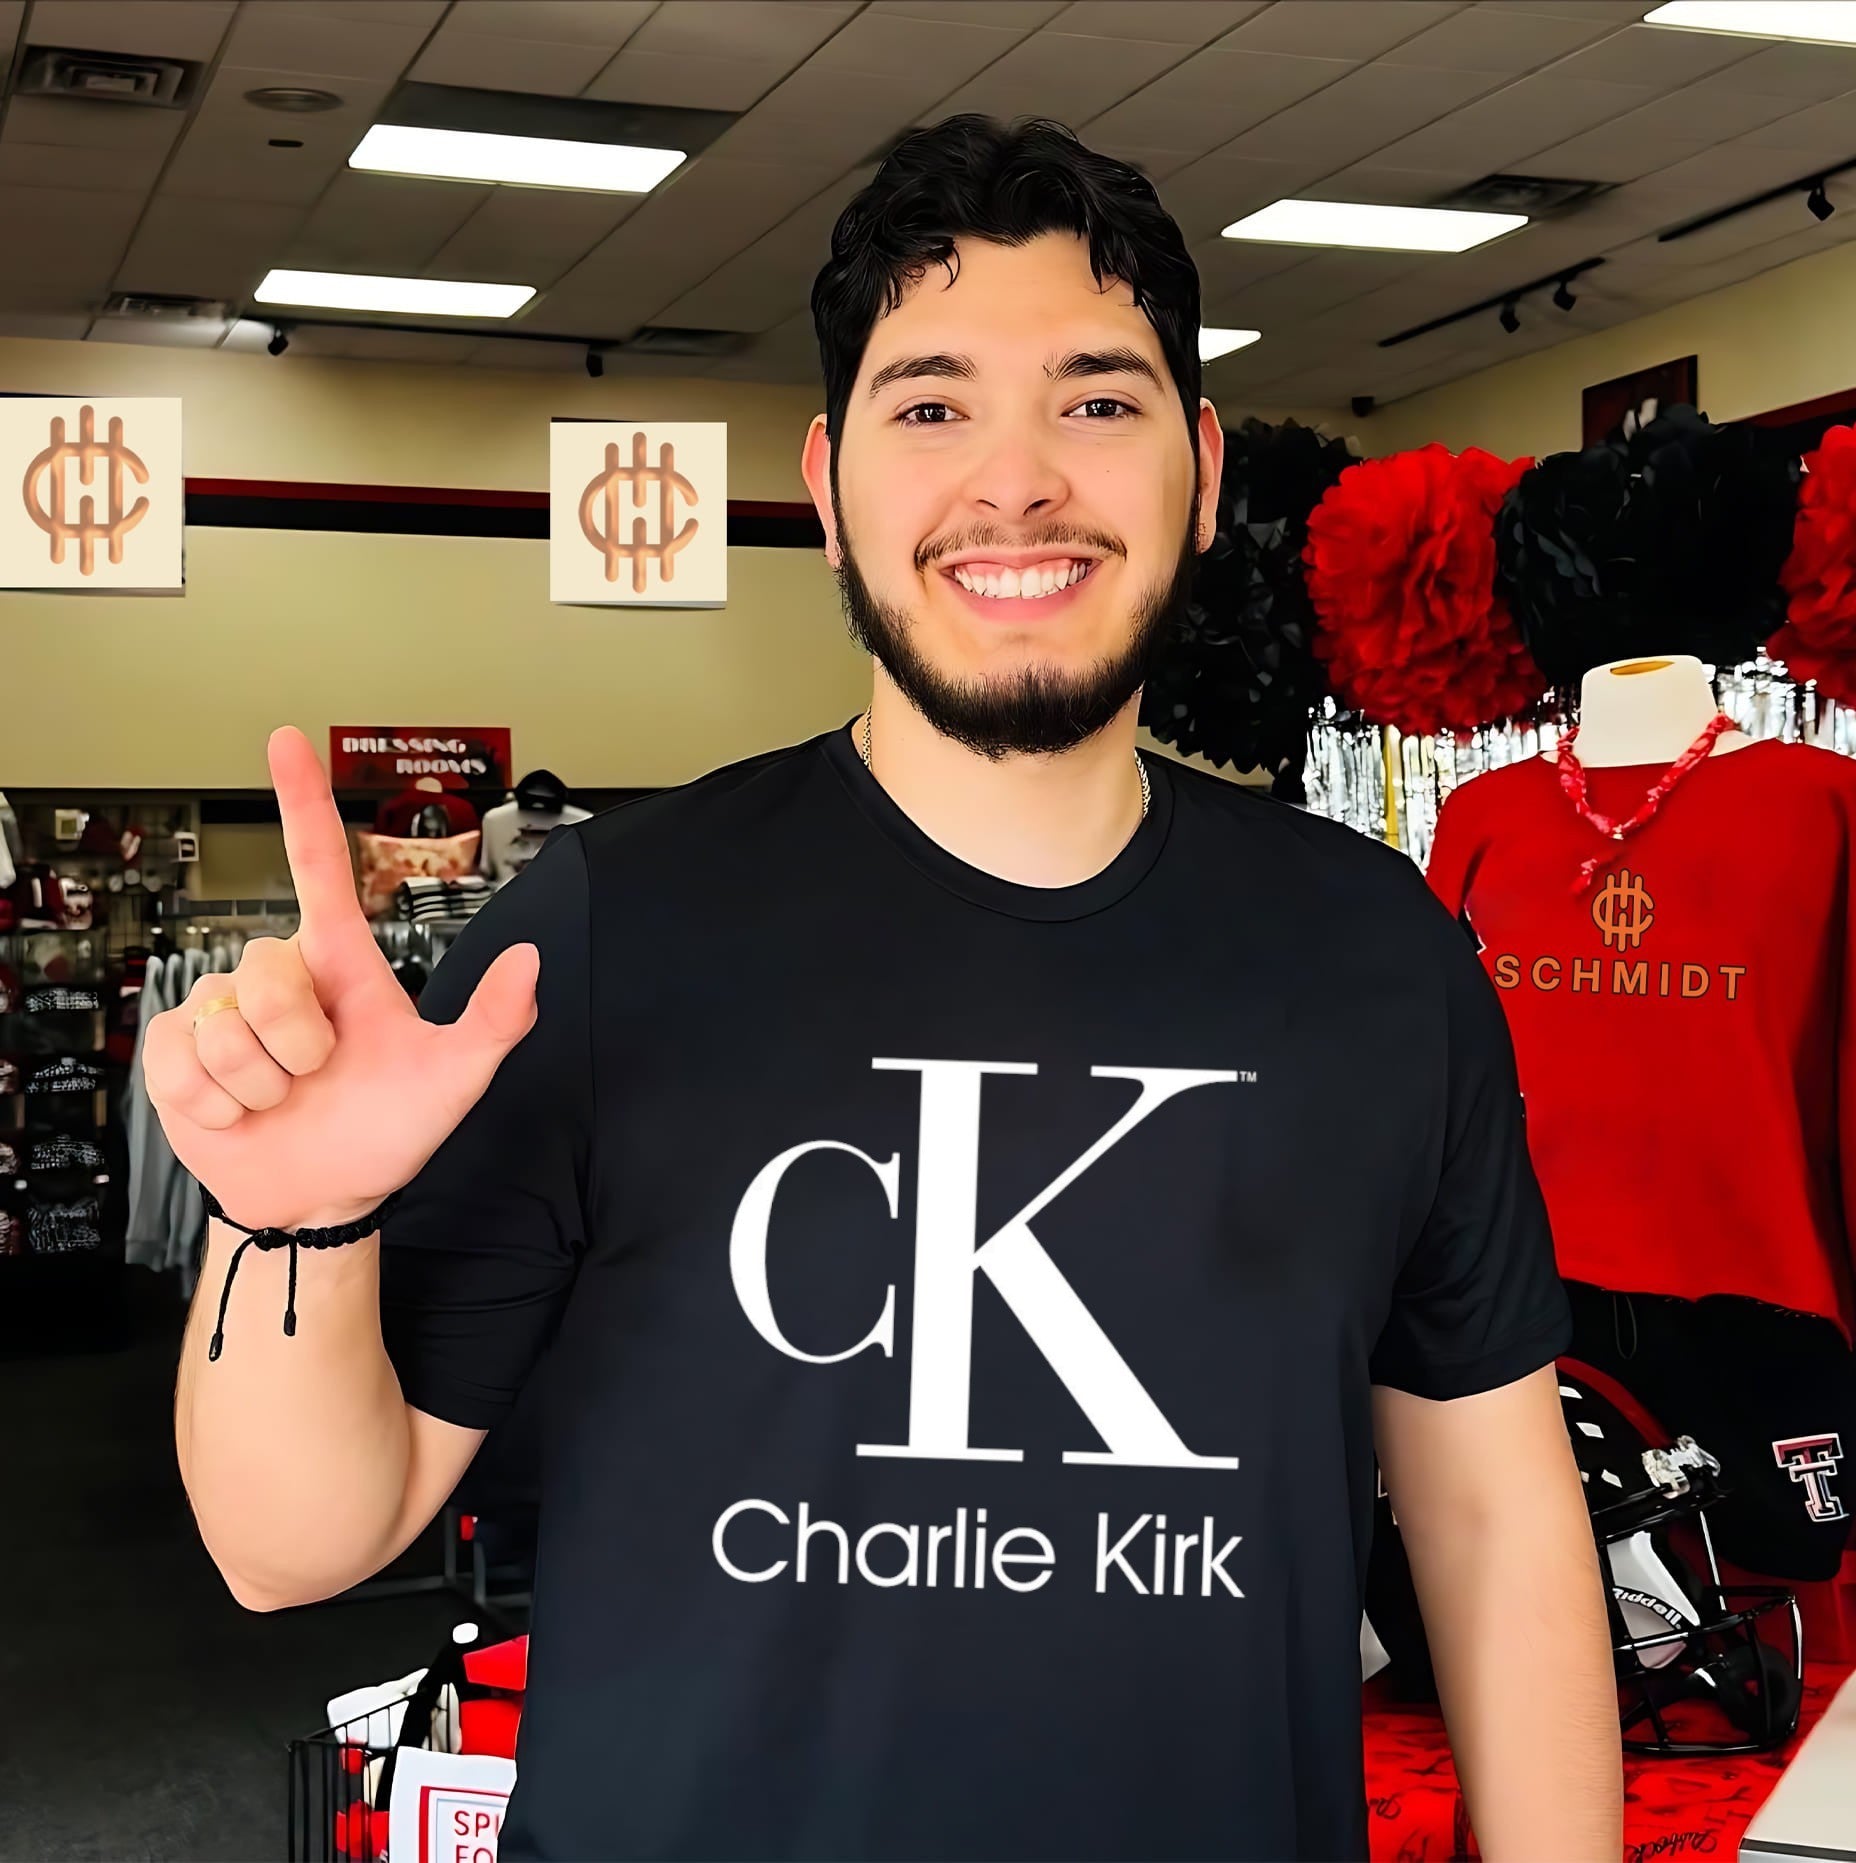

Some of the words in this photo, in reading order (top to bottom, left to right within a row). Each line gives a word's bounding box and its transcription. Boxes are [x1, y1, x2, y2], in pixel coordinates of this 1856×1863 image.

[342, 737, 466, 754] DRESSING
[396, 758, 487, 775] ROOMS
[1494, 954, 1747, 1000] SCHMIDT
[712, 1498, 1056, 1592] Charlie
[1095, 1511, 1246, 1598] Kirk
